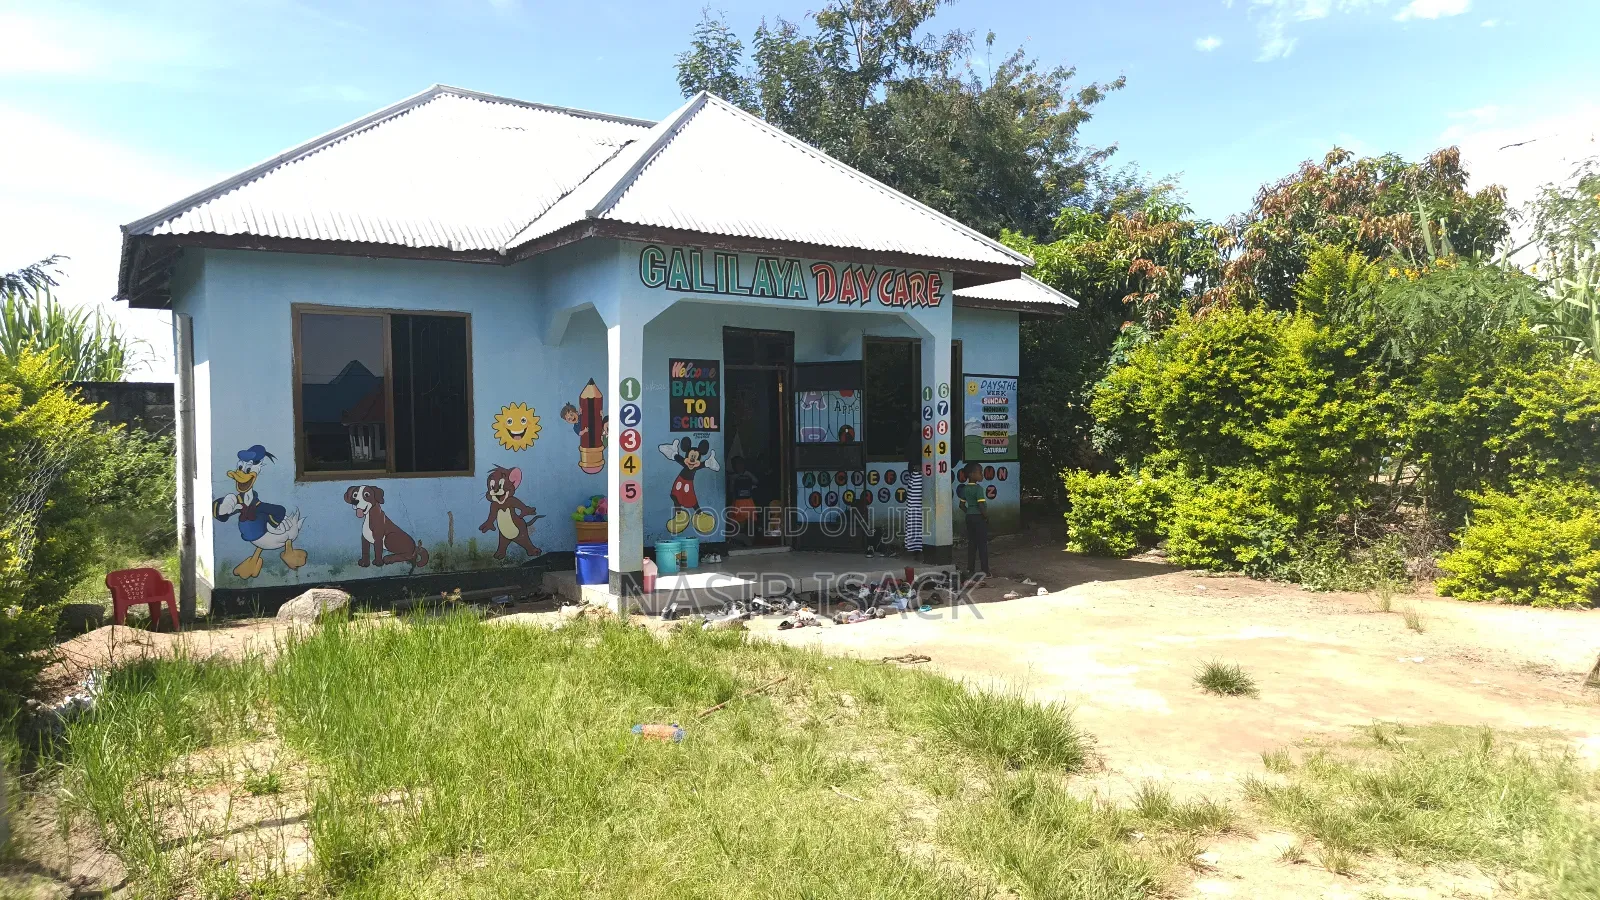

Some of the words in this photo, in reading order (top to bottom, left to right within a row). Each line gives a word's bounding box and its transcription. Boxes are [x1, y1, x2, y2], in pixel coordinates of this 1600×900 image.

[639, 245, 808, 300] GALILAYA
[672, 361, 716, 379] Welcome
[625, 380, 634, 398] 1
[672, 381, 717, 397] BACK
[623, 406, 637, 424] 2
[684, 399, 707, 414] TO
[673, 416, 718, 429] SCHOOL
[624, 430, 637, 449] 3
[624, 456, 636, 473] 4
[625, 484, 637, 499] 5
